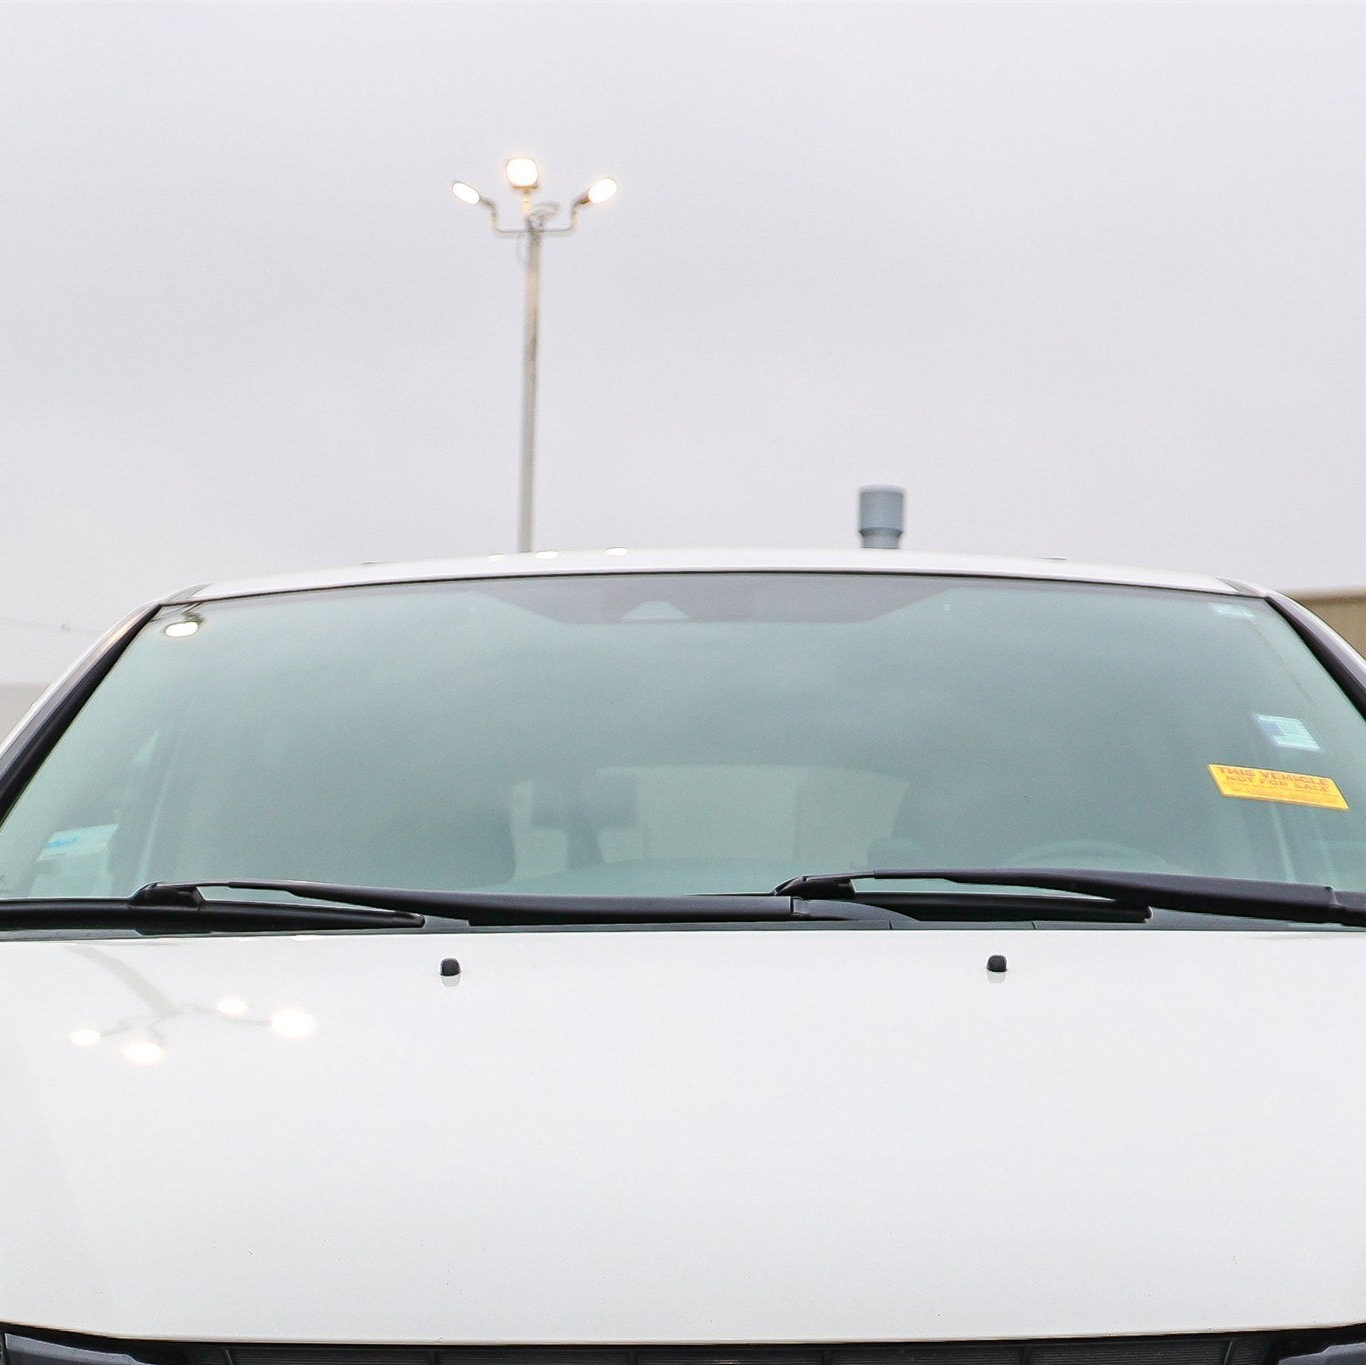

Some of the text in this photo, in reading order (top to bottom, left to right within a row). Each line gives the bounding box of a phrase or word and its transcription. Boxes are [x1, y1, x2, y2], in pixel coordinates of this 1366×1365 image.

[1217, 766, 1330, 787] THIS VEHICLE
[1225, 775, 1331, 792] NOT FOR SALE
